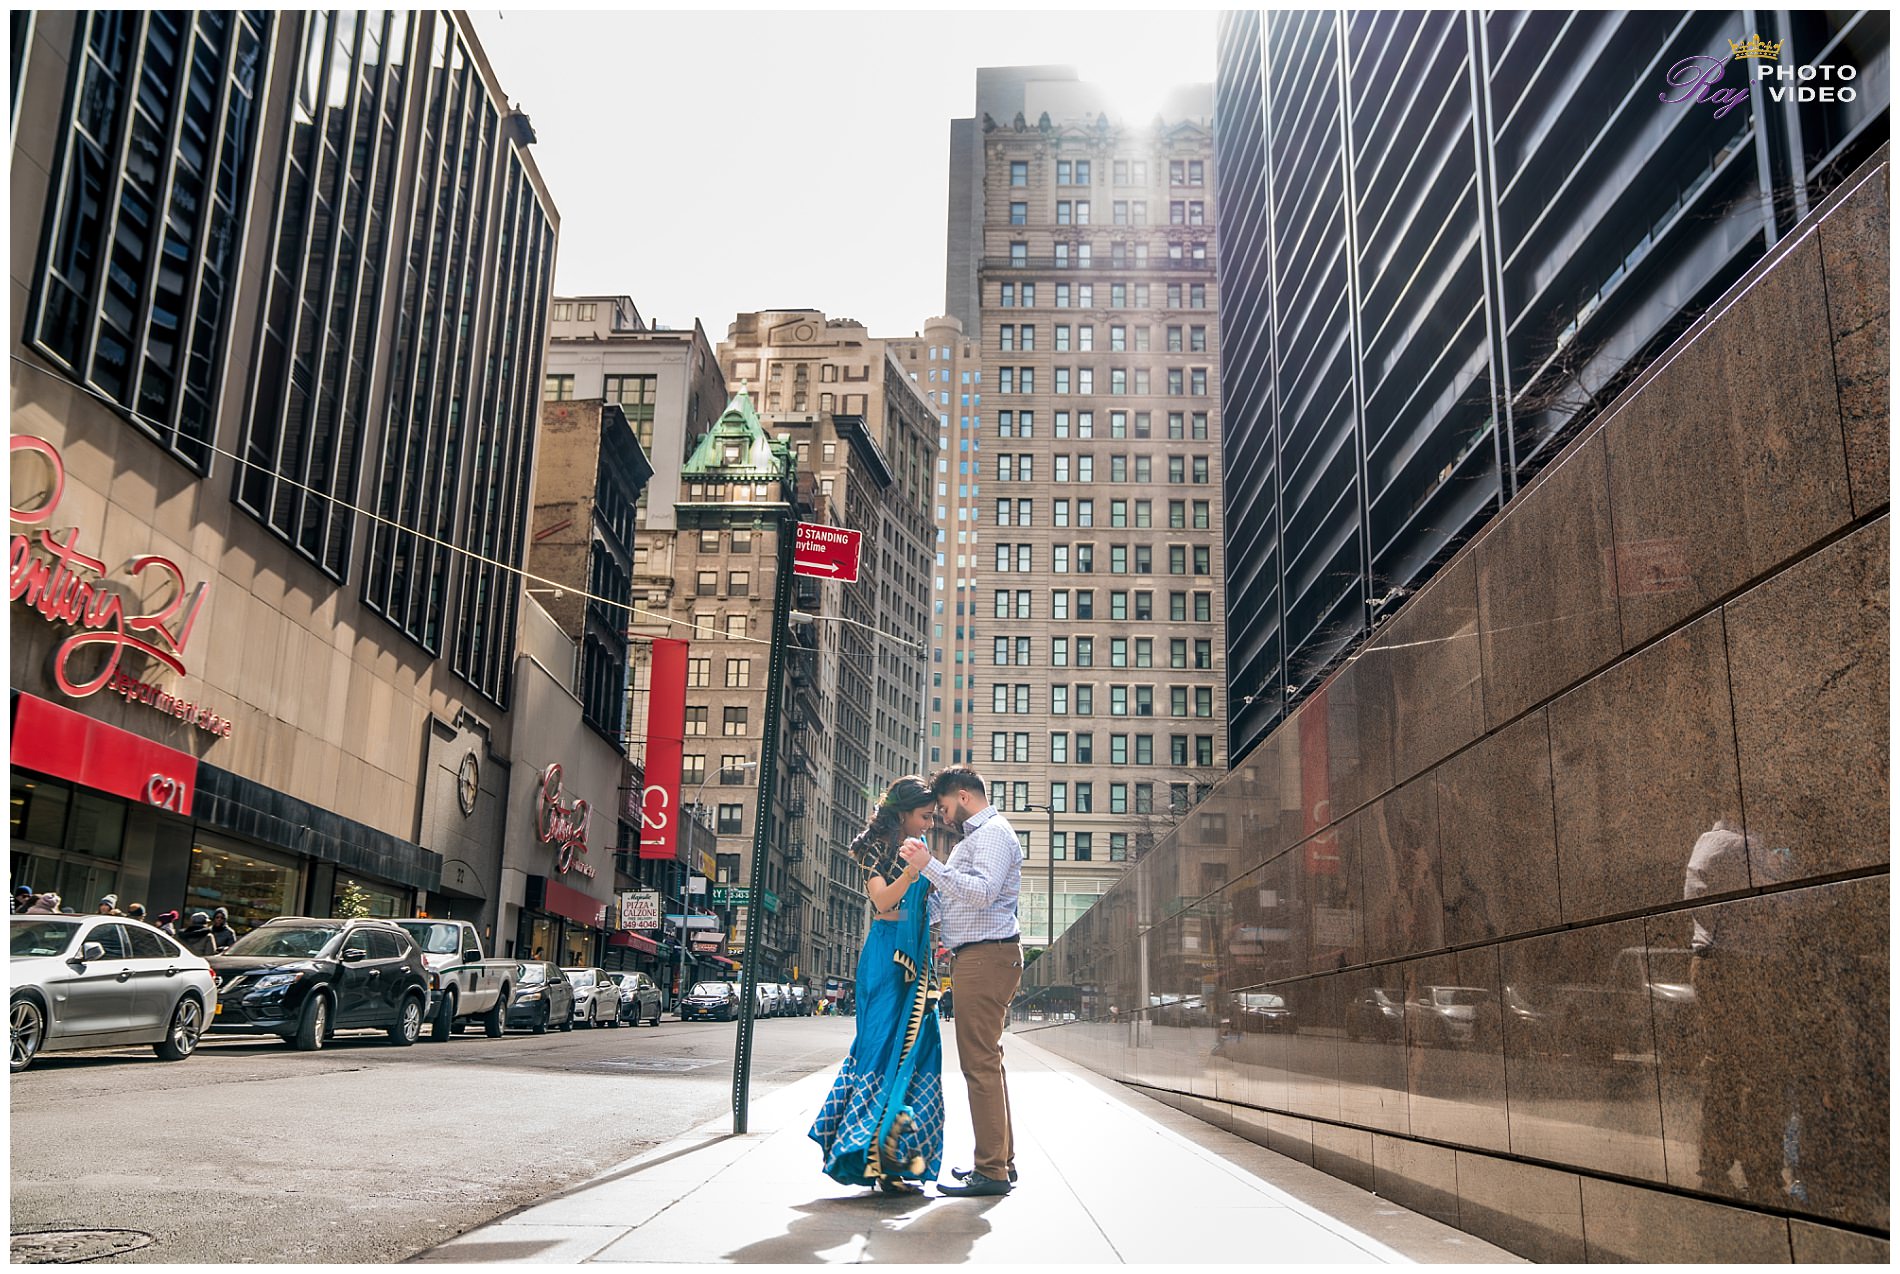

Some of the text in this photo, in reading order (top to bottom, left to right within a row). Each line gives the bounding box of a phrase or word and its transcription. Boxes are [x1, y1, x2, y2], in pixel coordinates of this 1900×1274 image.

[796, 541, 826, 552] nytime
[805, 529, 848, 544] STANDING
[122, 553, 211, 657] 21
[107, 663, 232, 740] department store
[148, 773, 186, 814] C21
[640, 784, 669, 845] C21
